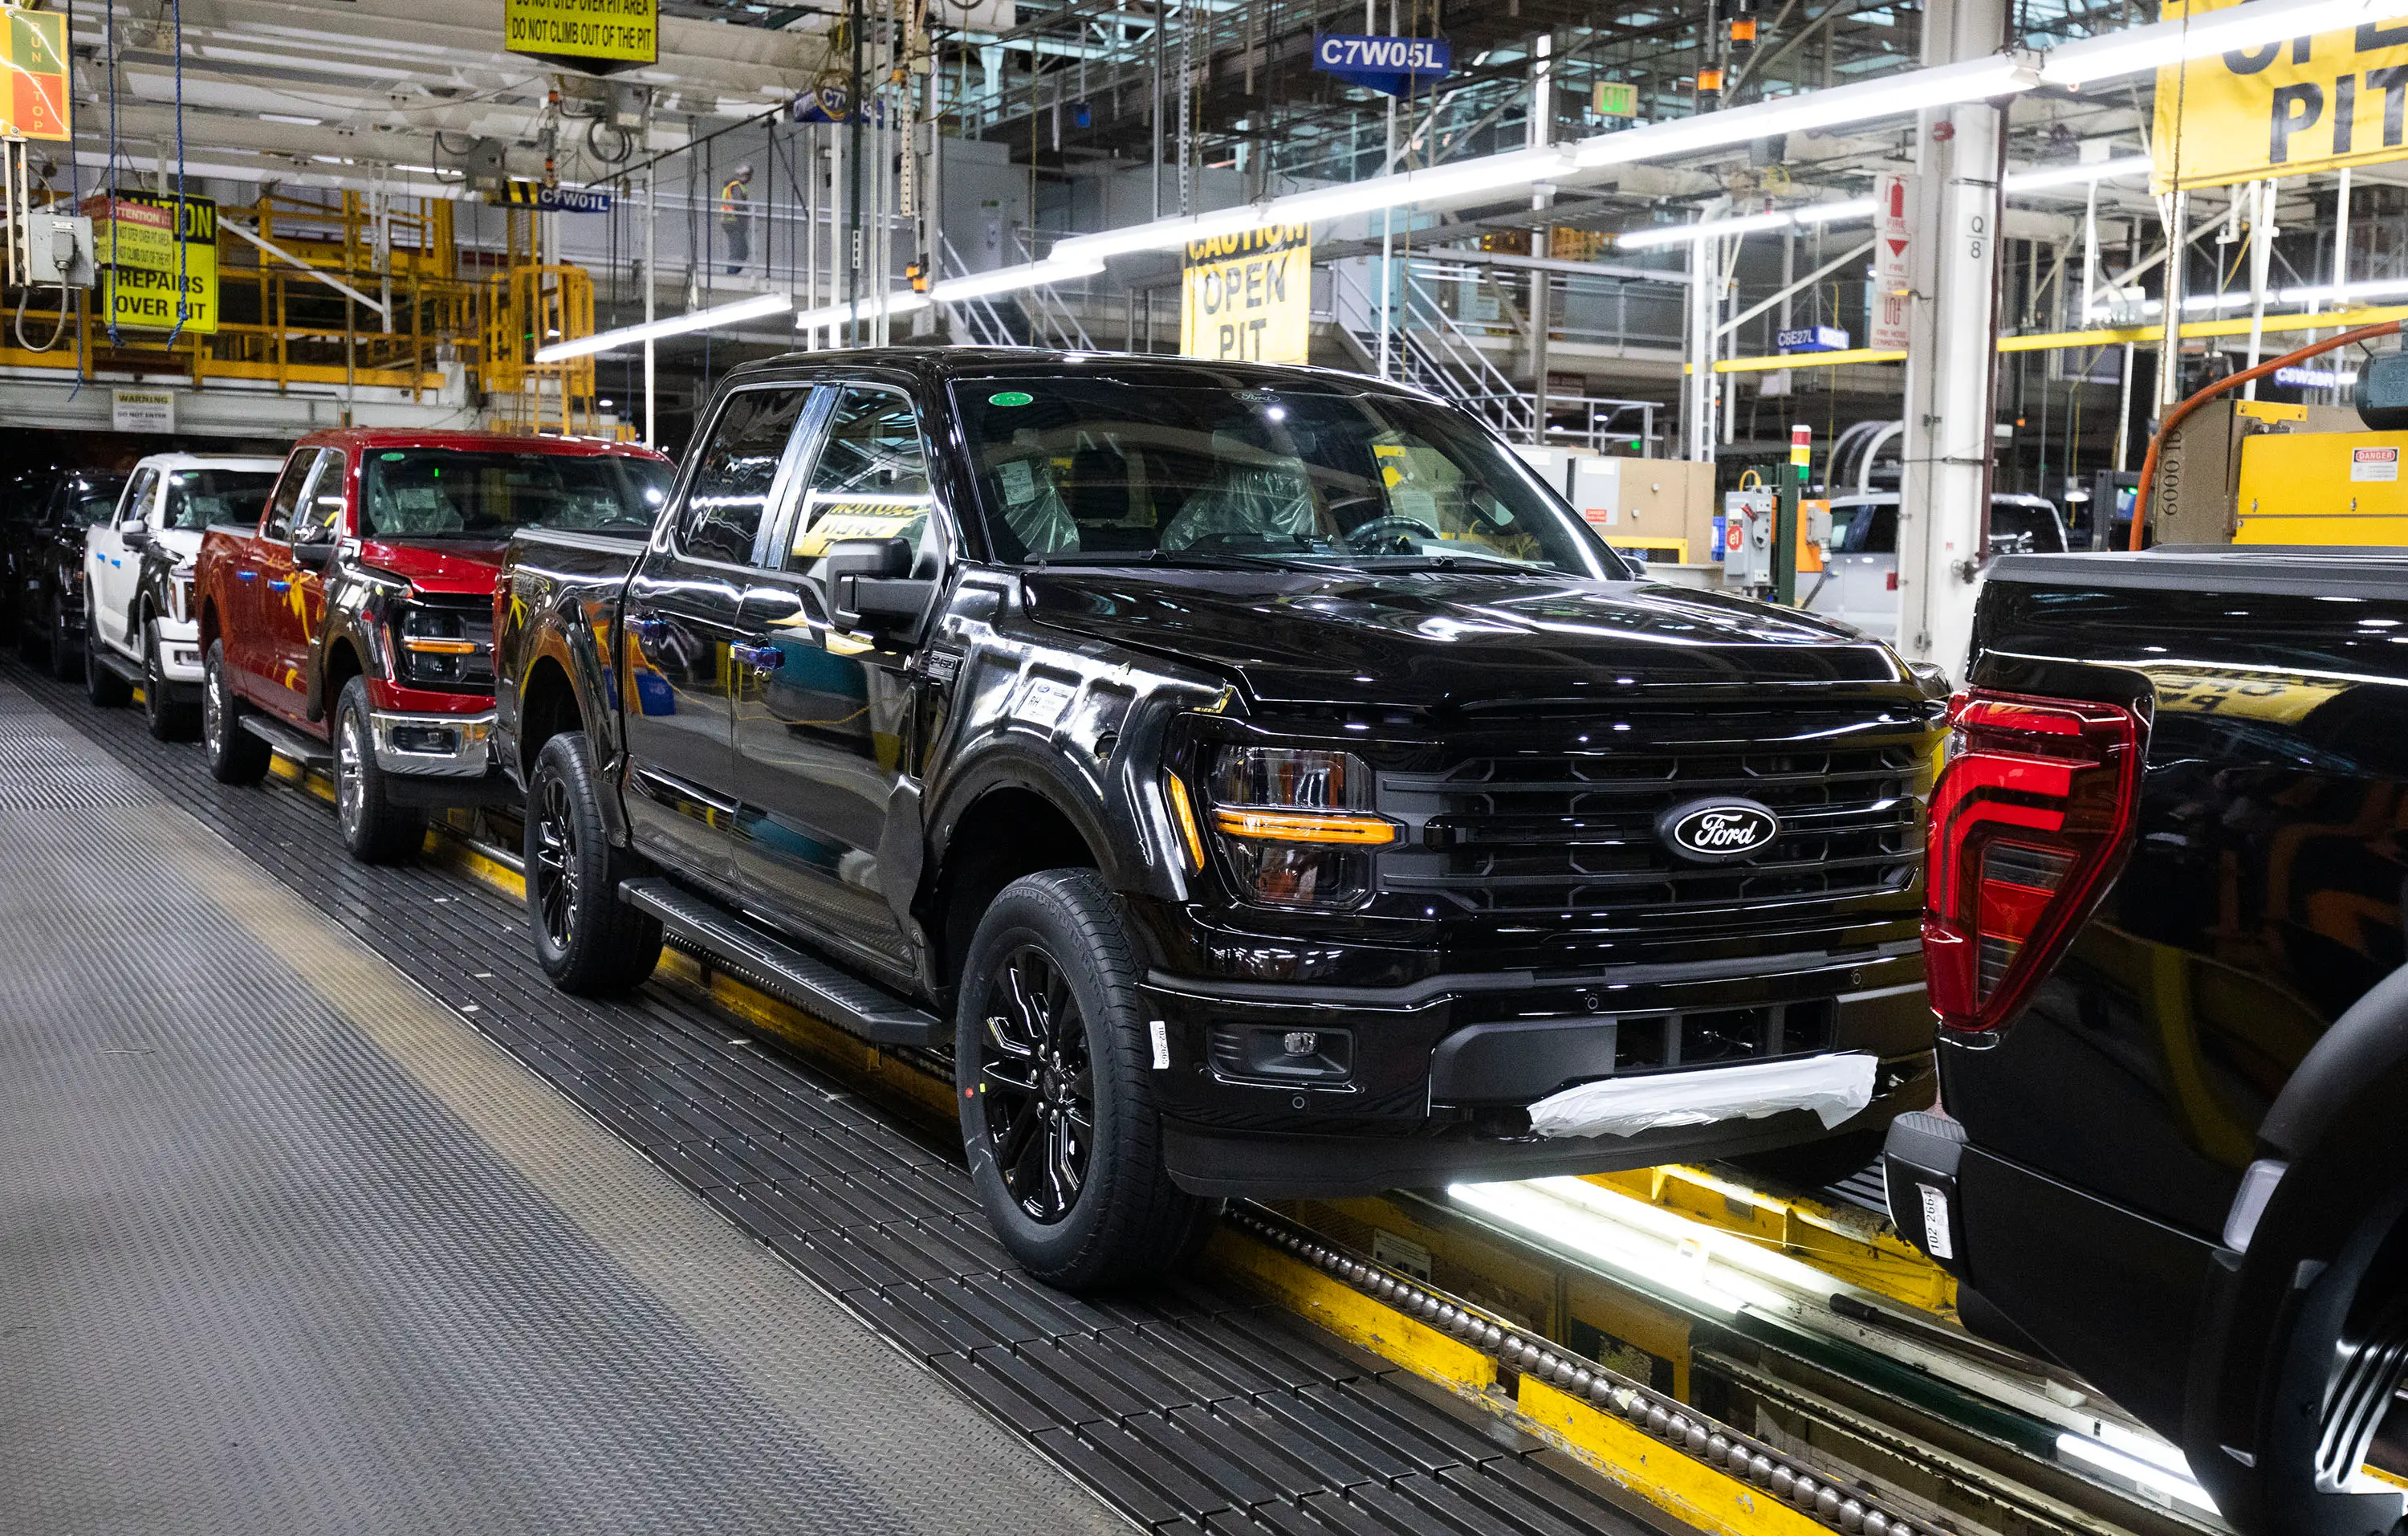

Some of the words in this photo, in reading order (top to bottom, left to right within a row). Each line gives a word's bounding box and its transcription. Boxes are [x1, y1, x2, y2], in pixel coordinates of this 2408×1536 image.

[512, 17, 527, 39] DO
[528, 18, 547, 41] NOT
[550, 20, 579, 44] CLIMB
[580, 22, 600, 46] OUT
[603, 25, 615, 47] OF
[617, 26, 635, 49] THE
[637, 27, 652, 51] PIT
[1321, 39, 1443, 68] C7W05L
[2269, 63, 2408, 165] PIT
[1971, 216, 1984, 234] Q
[1971, 241, 1981, 259] 8
[1204, 256, 1287, 315] OPEN
[116, 295, 169, 316] OVER
[1220, 318, 1267, 362] PIT
[2358, 451, 2393, 460] DANGER
[2162, 460, 2181, 515] 6000
[1027, 695, 1042, 707] RH
[1694, 813, 1758, 846] Ford
[1923, 1190, 1936, 1223] 2664
[1928, 1228, 1940, 1250] 102
